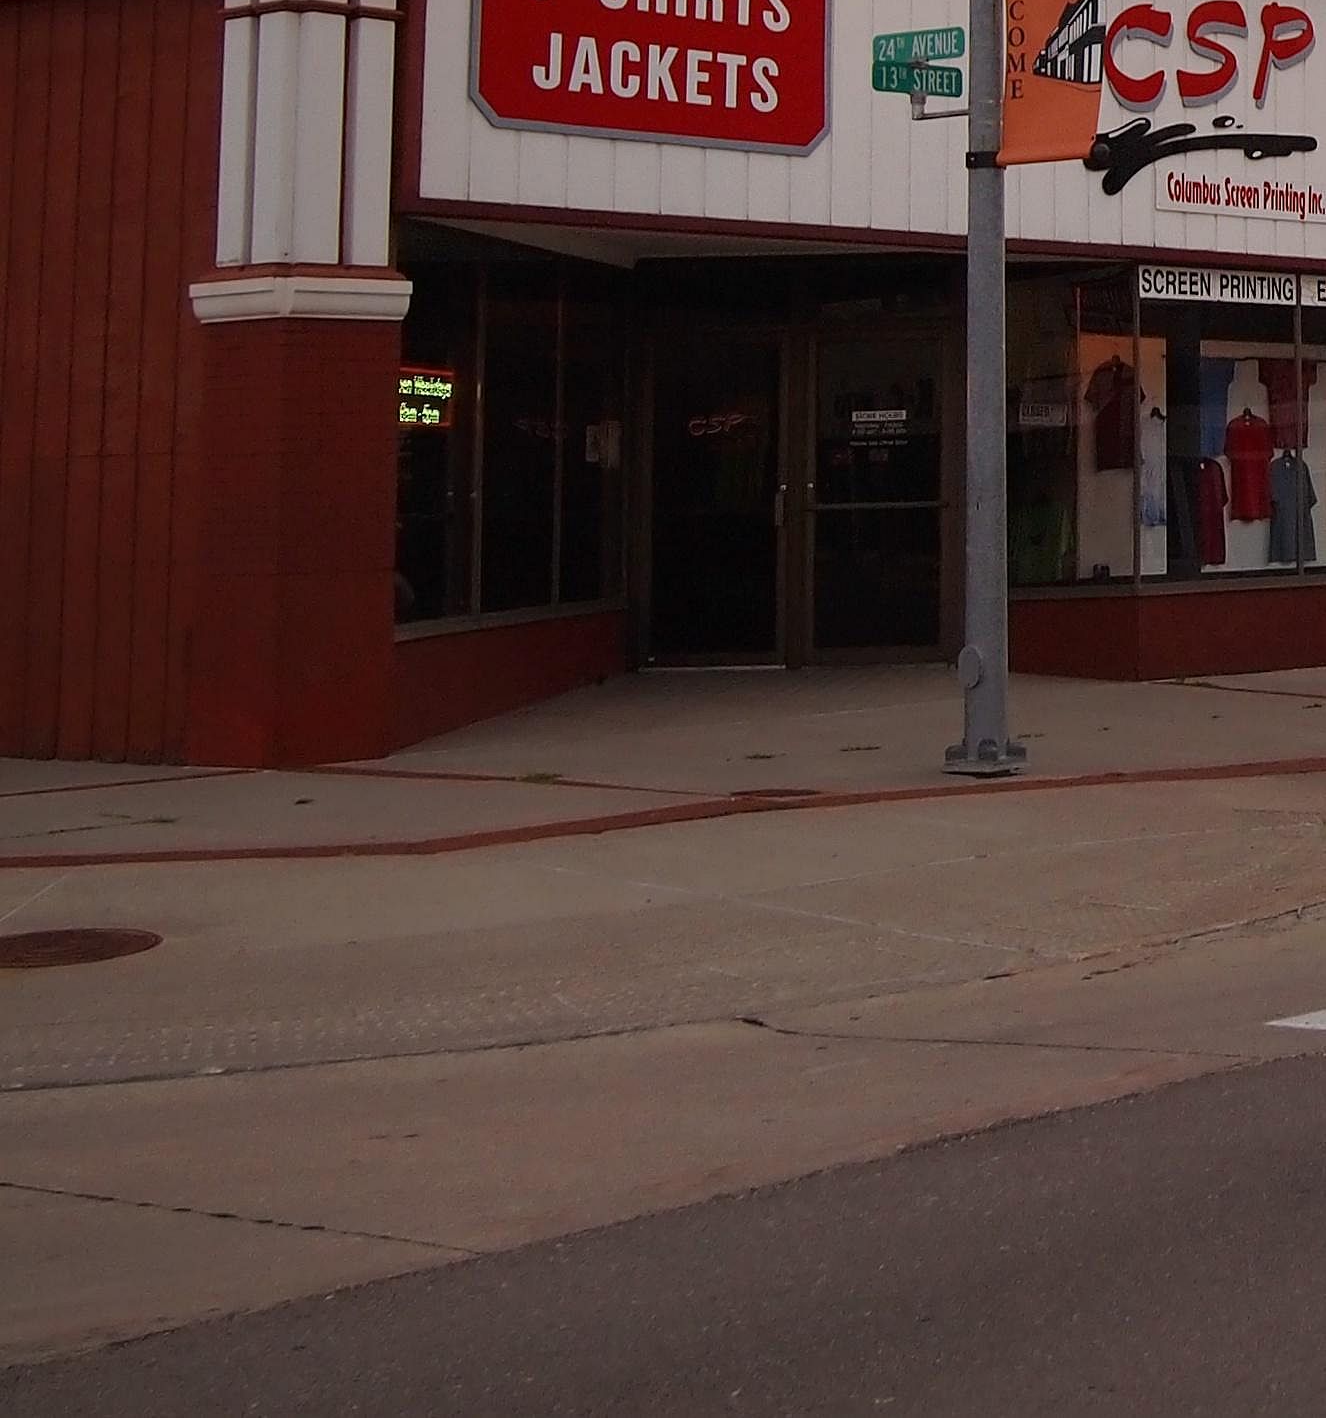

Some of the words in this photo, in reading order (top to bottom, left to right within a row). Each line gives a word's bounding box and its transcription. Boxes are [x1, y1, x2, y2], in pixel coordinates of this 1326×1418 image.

[911, 31, 959, 58] AVENUE
[1103, 0, 1316, 111] CSP
[532, 32, 781, 113] JACKETS
[913, 69, 958, 94] STREET
[1167, 171, 1221, 207] Columbus
[1225, 176, 1260, 210] Screen
[1263, 180, 1306, 220] Printing
[1308, 184, 1326, 215] Inc.
[1141, 268, 1211, 297] SCREEN
[1219, 272, 1294, 303] PRINTING
